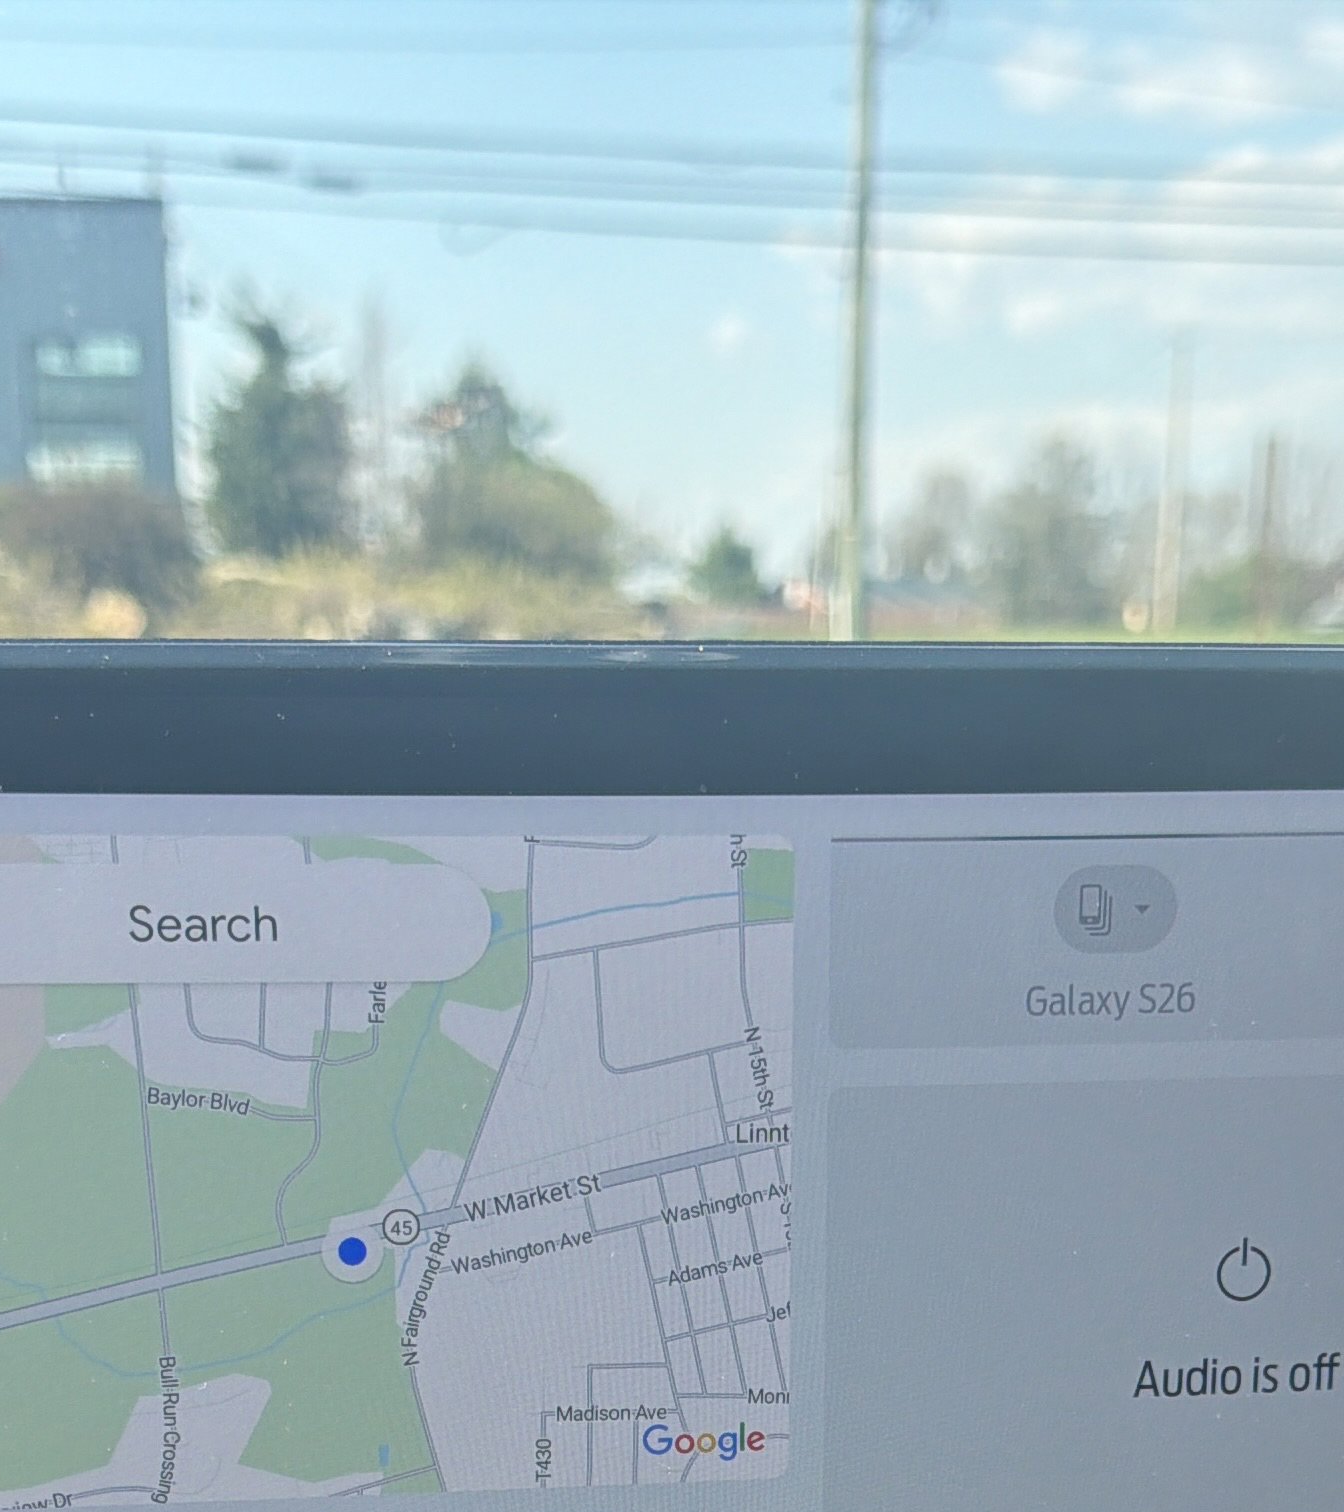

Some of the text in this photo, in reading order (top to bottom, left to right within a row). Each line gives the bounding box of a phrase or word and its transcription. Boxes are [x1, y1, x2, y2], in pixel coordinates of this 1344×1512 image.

[730, 849, 748, 868] St
[129, 904, 278, 943] Search
[1026, 982, 1196, 1021] Galaxy S26
[744, 1026, 774, 1110] N 15th St
[147, 1087, 251, 1116] Baylor Blvd
[464, 1174, 602, 1221] W Market St
[661, 1183, 792, 1225] Washington Av
[390, 1220, 413, 1236] 45
[451, 1230, 593, 1275] Washington Ave
[668, 1252, 763, 1286] Adams Ave
[401, 1230, 451, 1366] N Fairground Rd
[1132, 1351, 1342, 1398] Audio is off
[150, 1356, 181, 1505] Bull Run Crossing
[556, 1404, 667, 1422] Madison Ave
[642, 1421, 765, 1461] Google
[52, 1492, 73, 1509] Dr
